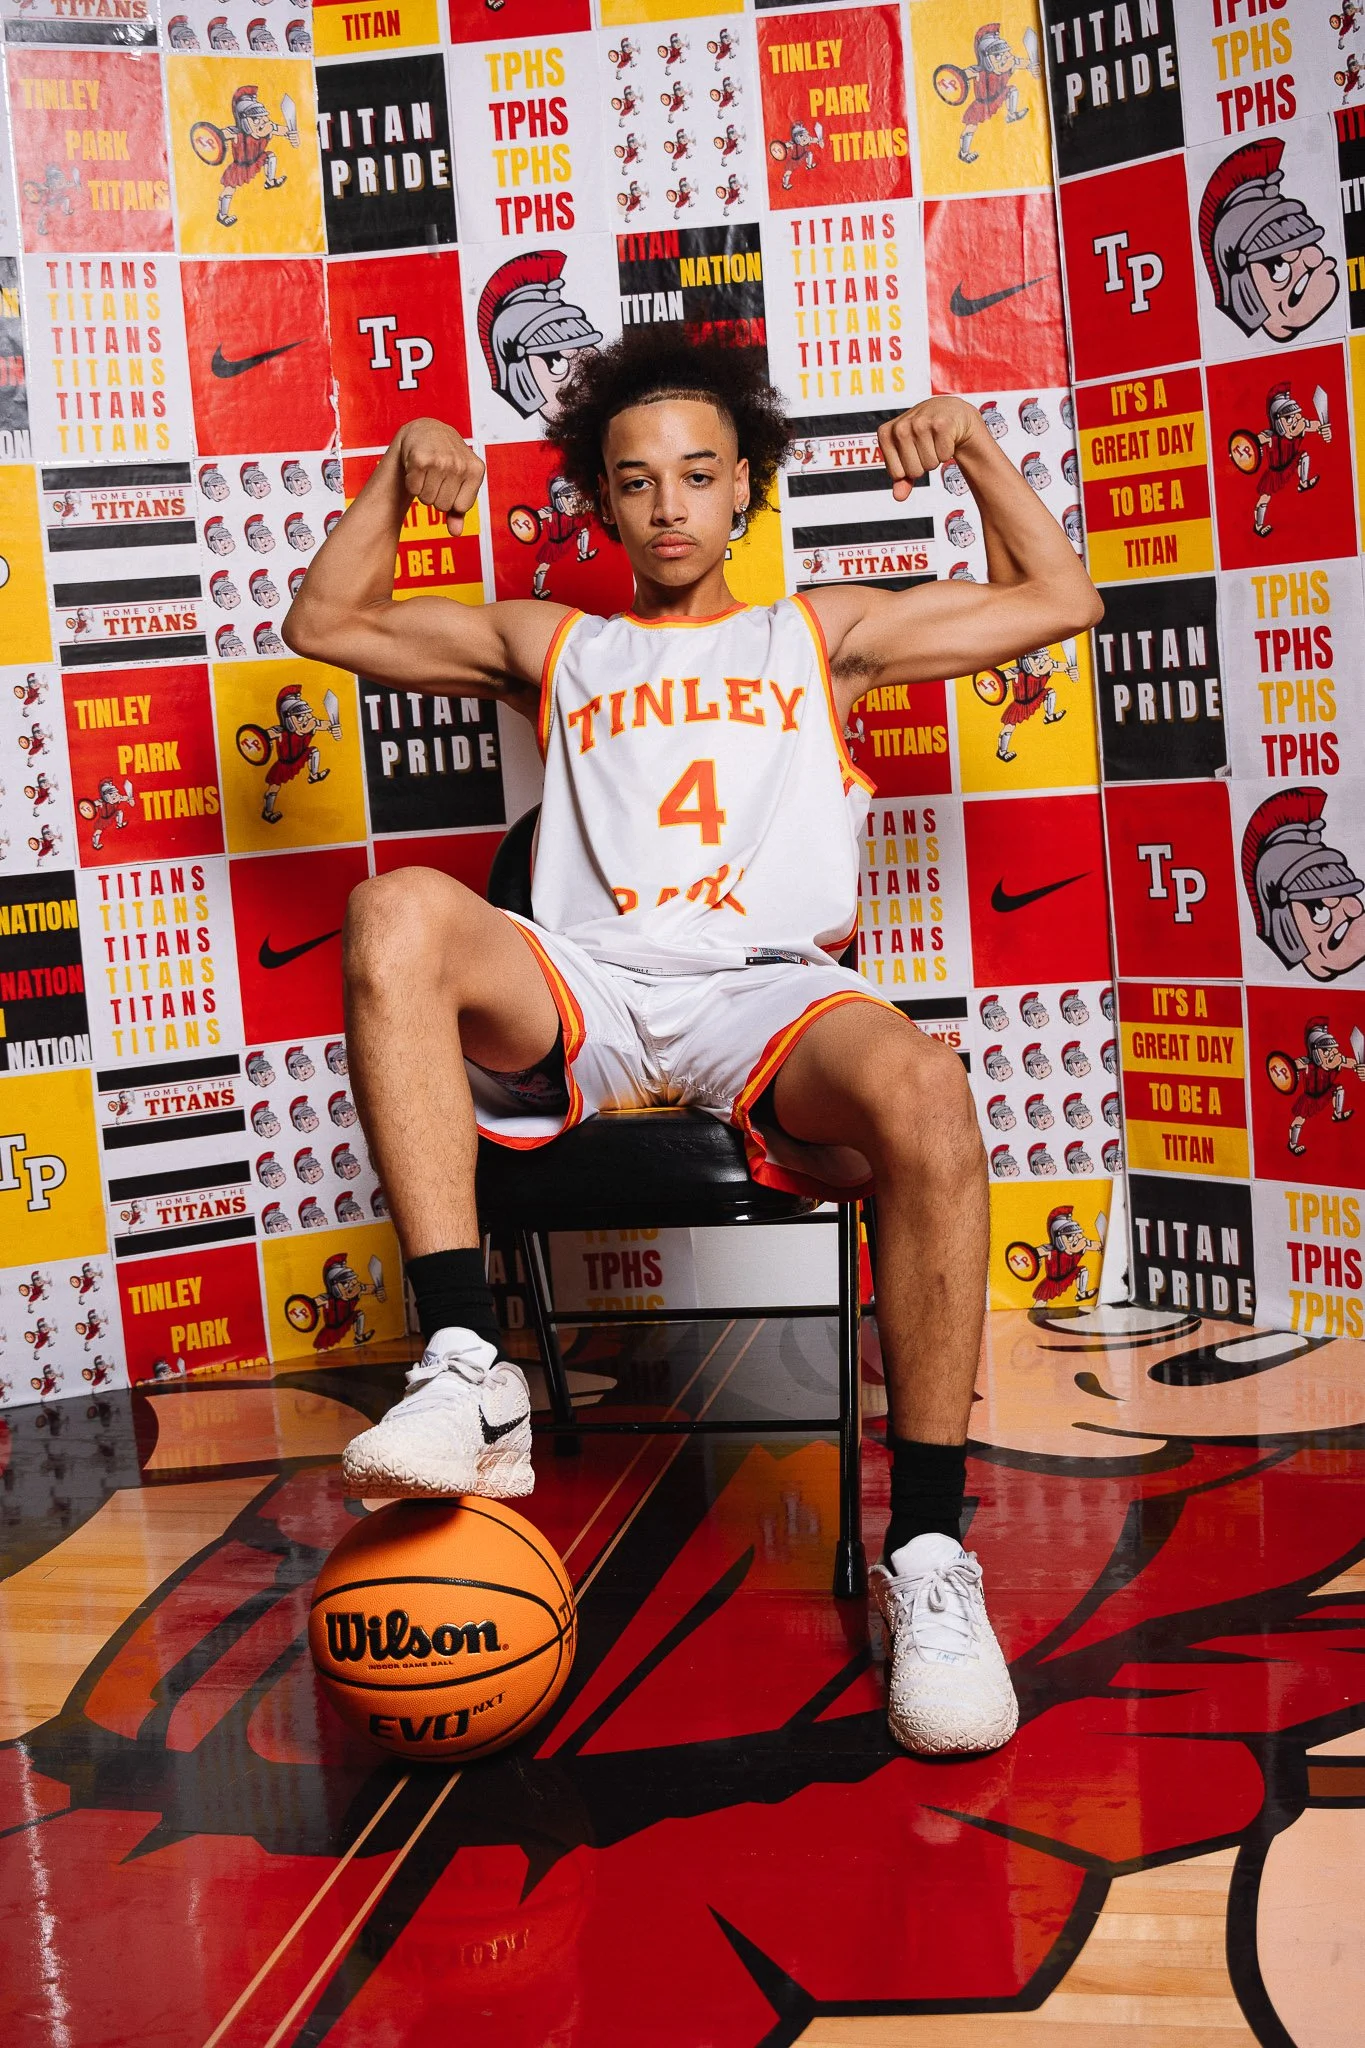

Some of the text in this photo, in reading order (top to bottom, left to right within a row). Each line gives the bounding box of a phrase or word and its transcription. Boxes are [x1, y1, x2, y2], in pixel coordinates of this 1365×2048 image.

[53, 0, 147, 19] TITANS
[342, 9, 400, 41] TITAN
[1050, 0, 1159, 64] TITAN
[1212, 17, 1292, 81] TPHS
[485, 47, 565, 93] TPHS
[768, 38, 843, 75] TINLEY
[17, 78, 102, 111] TINLEY
[1066, 45, 1175, 114] PRIDE
[810, 84, 871, 118] PARK
[1216, 73, 1297, 136] TPHS
[317, 102, 433, 150] TITAN
[489, 96, 569, 142] TPHS
[65, 130, 130, 160] PARK
[830, 128, 909, 164] TITANS
[332, 152, 449, 197] PRIDE
[492, 143, 572, 189] TPHS
[88, 180, 170, 211] TITANS
[495, 191, 575, 236] TPHS
[791, 213, 895, 246] TITANS
[617, 229, 680, 263] TITAN
[791, 243, 899, 276] TITANS
[46, 261, 157, 289] TITANS
[680, 252, 762, 288] NATION
[1093, 232, 1163, 314] TP
[48, 292, 161, 321] TITANS
[621, 290, 685, 325] TITAN
[795, 274, 900, 307] TITANS
[795, 304, 902, 338] TITANS
[51, 326, 162, 354] TITANS
[358, 315, 434, 390] TP
[799, 336, 902, 368] TITANS
[52, 358, 166, 387] TITANS
[799, 366, 906, 400] TITANS
[56, 390, 167, 420] TITANS
[1110, 378, 1168, 416] IT'S A
[57, 423, 170, 453] TITANS
[829, 440, 863, 448] HOME
[1091, 422, 1195, 466] GREAT DAY
[1232, 444, 1253, 459] TP
[830, 447, 886, 466] TITA
[91, 489, 184, 501] HOME OF THE
[92, 498, 186, 520] TITANS
[1109, 479, 1184, 517] TO BE A
[512, 518, 532, 531] TP
[407, 549, 434, 578] BE
[441, 547, 455, 575] A
[838, 549, 872, 557] HOME
[839, 553, 928, 575] TITANS
[1124, 534, 1178, 568] TITAN
[103, 603, 196, 617] HOME OF THE
[1250, 570, 1331, 620] TPHS
[104, 613, 197, 636] TITANS
[1099, 626, 1207, 673] TITAN
[1254, 625, 1334, 673] TPHS
[977, 679, 997, 692] TP
[1113, 680, 1223, 723] PRIDE
[1258, 677, 1337, 725] TPHS
[74, 694, 152, 731] TINLEY
[364, 692, 480, 731] TITAN
[568, 677, 805, 755] TINLEY
[118, 741, 182, 775] PARK
[241, 737, 260, 751] TP
[380, 732, 496, 777] PRIDE
[870, 725, 947, 758] TITANS
[1261, 732, 1341, 778] TPHS
[139, 785, 219, 822] TITANS
[657, 758, 727, 846] 4
[866, 808, 936, 837] TANS
[865, 836, 940, 866] TANS
[98, 865, 205, 900] TITANS
[858, 867, 940, 897] ITANS
[1137, 844, 1207, 924] TP
[99, 894, 209, 931] TITANS
[858, 896, 944, 926] ITANS
[104, 927, 210, 963] TITANS
[859, 926, 944, 956] ITANS
[0, 964, 85, 1002] NATION
[105, 956, 215, 994] TITANS
[860, 956, 948, 985] ITANS
[110, 988, 216, 1025] TITANS
[1152, 988, 1208, 1019] IT'S A
[112, 1018, 220, 1056] TITANS
[938, 1023, 960, 1031] THE
[6, 1033, 92, 1070] NATION
[1132, 1032, 1234, 1064] GREAT DAY
[144, 1080, 233, 1098] HOME OF THE
[1270, 1065, 1289, 1080] TP
[145, 1089, 235, 1116] TITANS
[1149, 1082, 1222, 1115] TO BE A
[1162, 1134, 1214, 1164] TITAN
[0, 1133, 67, 1212] TP
[156, 1188, 245, 1207] HOME OF THE
[157, 1196, 247, 1225] TITANS
[1284, 1191, 1360, 1239] TPHS
[1135, 1217, 1239, 1266] TITAN
[582, 1249, 663, 1290] TPHS
[1010, 1254, 1030, 1267] TP
[1286, 1241, 1363, 1290] TPHS
[128, 1276, 202, 1315] TINLEY
[1148, 1267, 1252, 1316] PRIDE
[289, 1306, 308, 1318] TP
[1288, 1289, 1364, 1338] TPHS
[170, 1317, 232, 1353] PARK
[325, 1609, 502, 1662] Wilson
[368, 1663, 400, 1671] INDOOR
[369, 1692, 506, 1742] EVO NXT
